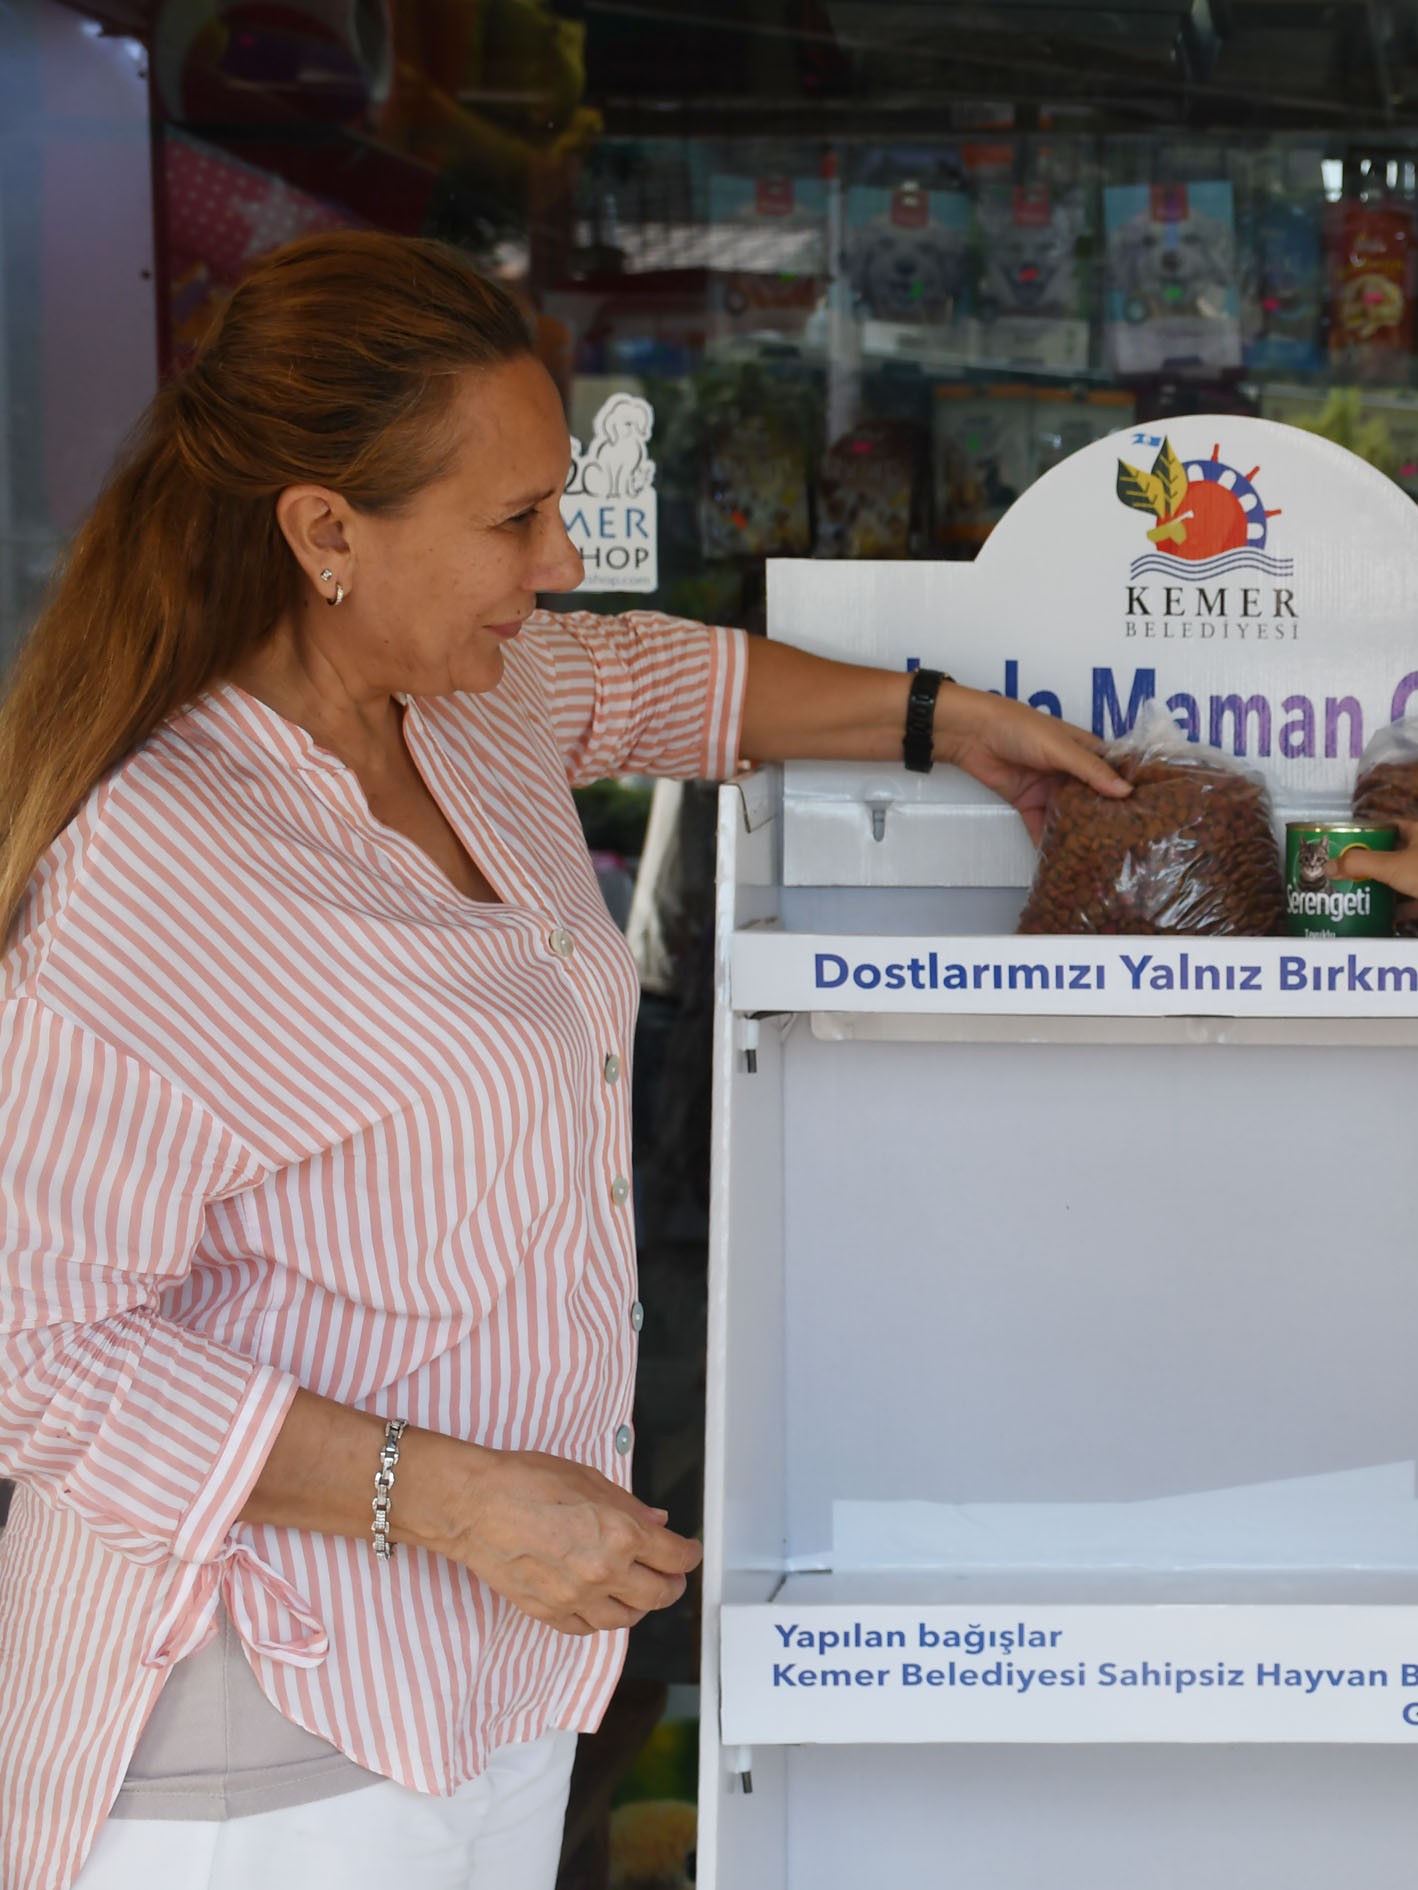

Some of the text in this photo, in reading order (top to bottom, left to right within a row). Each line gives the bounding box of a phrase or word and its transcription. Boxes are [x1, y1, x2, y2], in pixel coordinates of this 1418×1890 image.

[566, 507, 649, 540] MER
[580, 546, 649, 570] HOP
[1125, 586, 1299, 618] KEMER
[1125, 620, 1299, 640] BELEDİYESİ
[1092, 667, 1364, 759] Maman
[1287, 884, 1371, 922] Serengeti
[814, 952, 1105, 991] Dostlarımızı
[1120, 953, 1263, 993] Yalnız
[774, 1622, 1063, 1655] Yapılan bağışlar
[773, 1663, 890, 1686] Kemer
[901, 1662, 1086, 1693] Belediyesi
[1098, 1662, 1245, 1693] Sahipsiz
[1257, 1663, 1388, 1693] Hayvan
